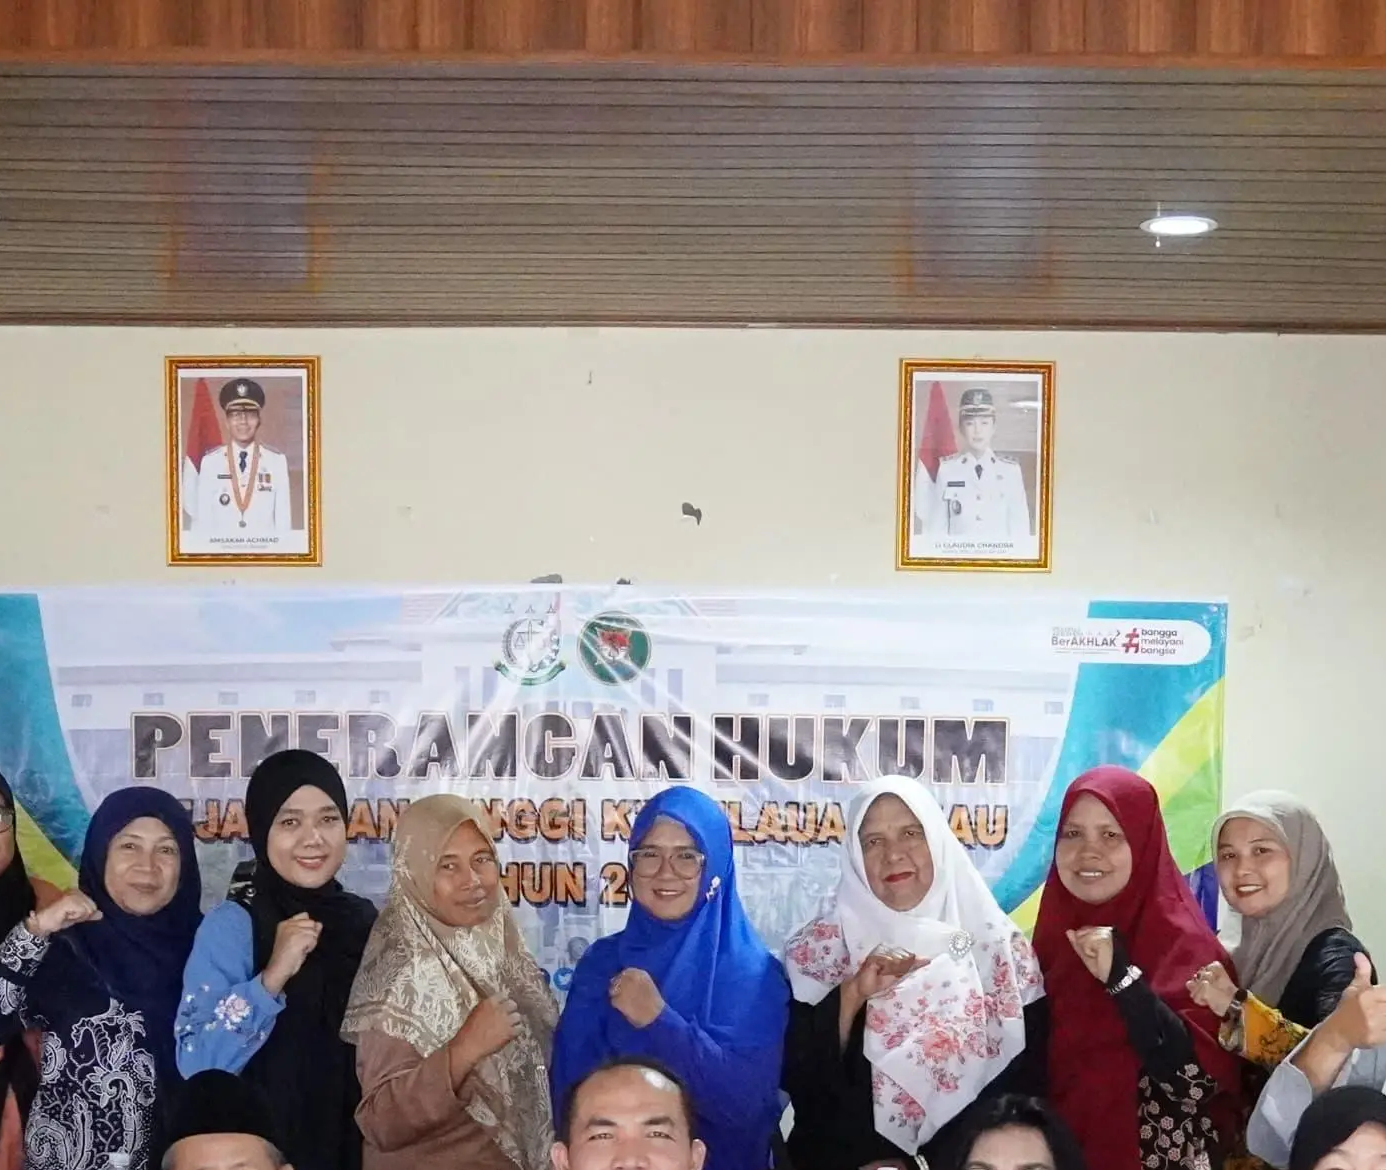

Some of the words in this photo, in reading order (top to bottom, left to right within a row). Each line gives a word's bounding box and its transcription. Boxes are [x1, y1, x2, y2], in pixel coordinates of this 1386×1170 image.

[1141, 628, 1178, 639] bangga
[1051, 636, 1118, 647] BerAKHLAK
[1141, 637, 1184, 647] melayani
[1141, 646, 1176, 656] bangsa
[129, 710, 696, 783] PENERANGAN
[710, 713, 1010, 786] HUKUM
